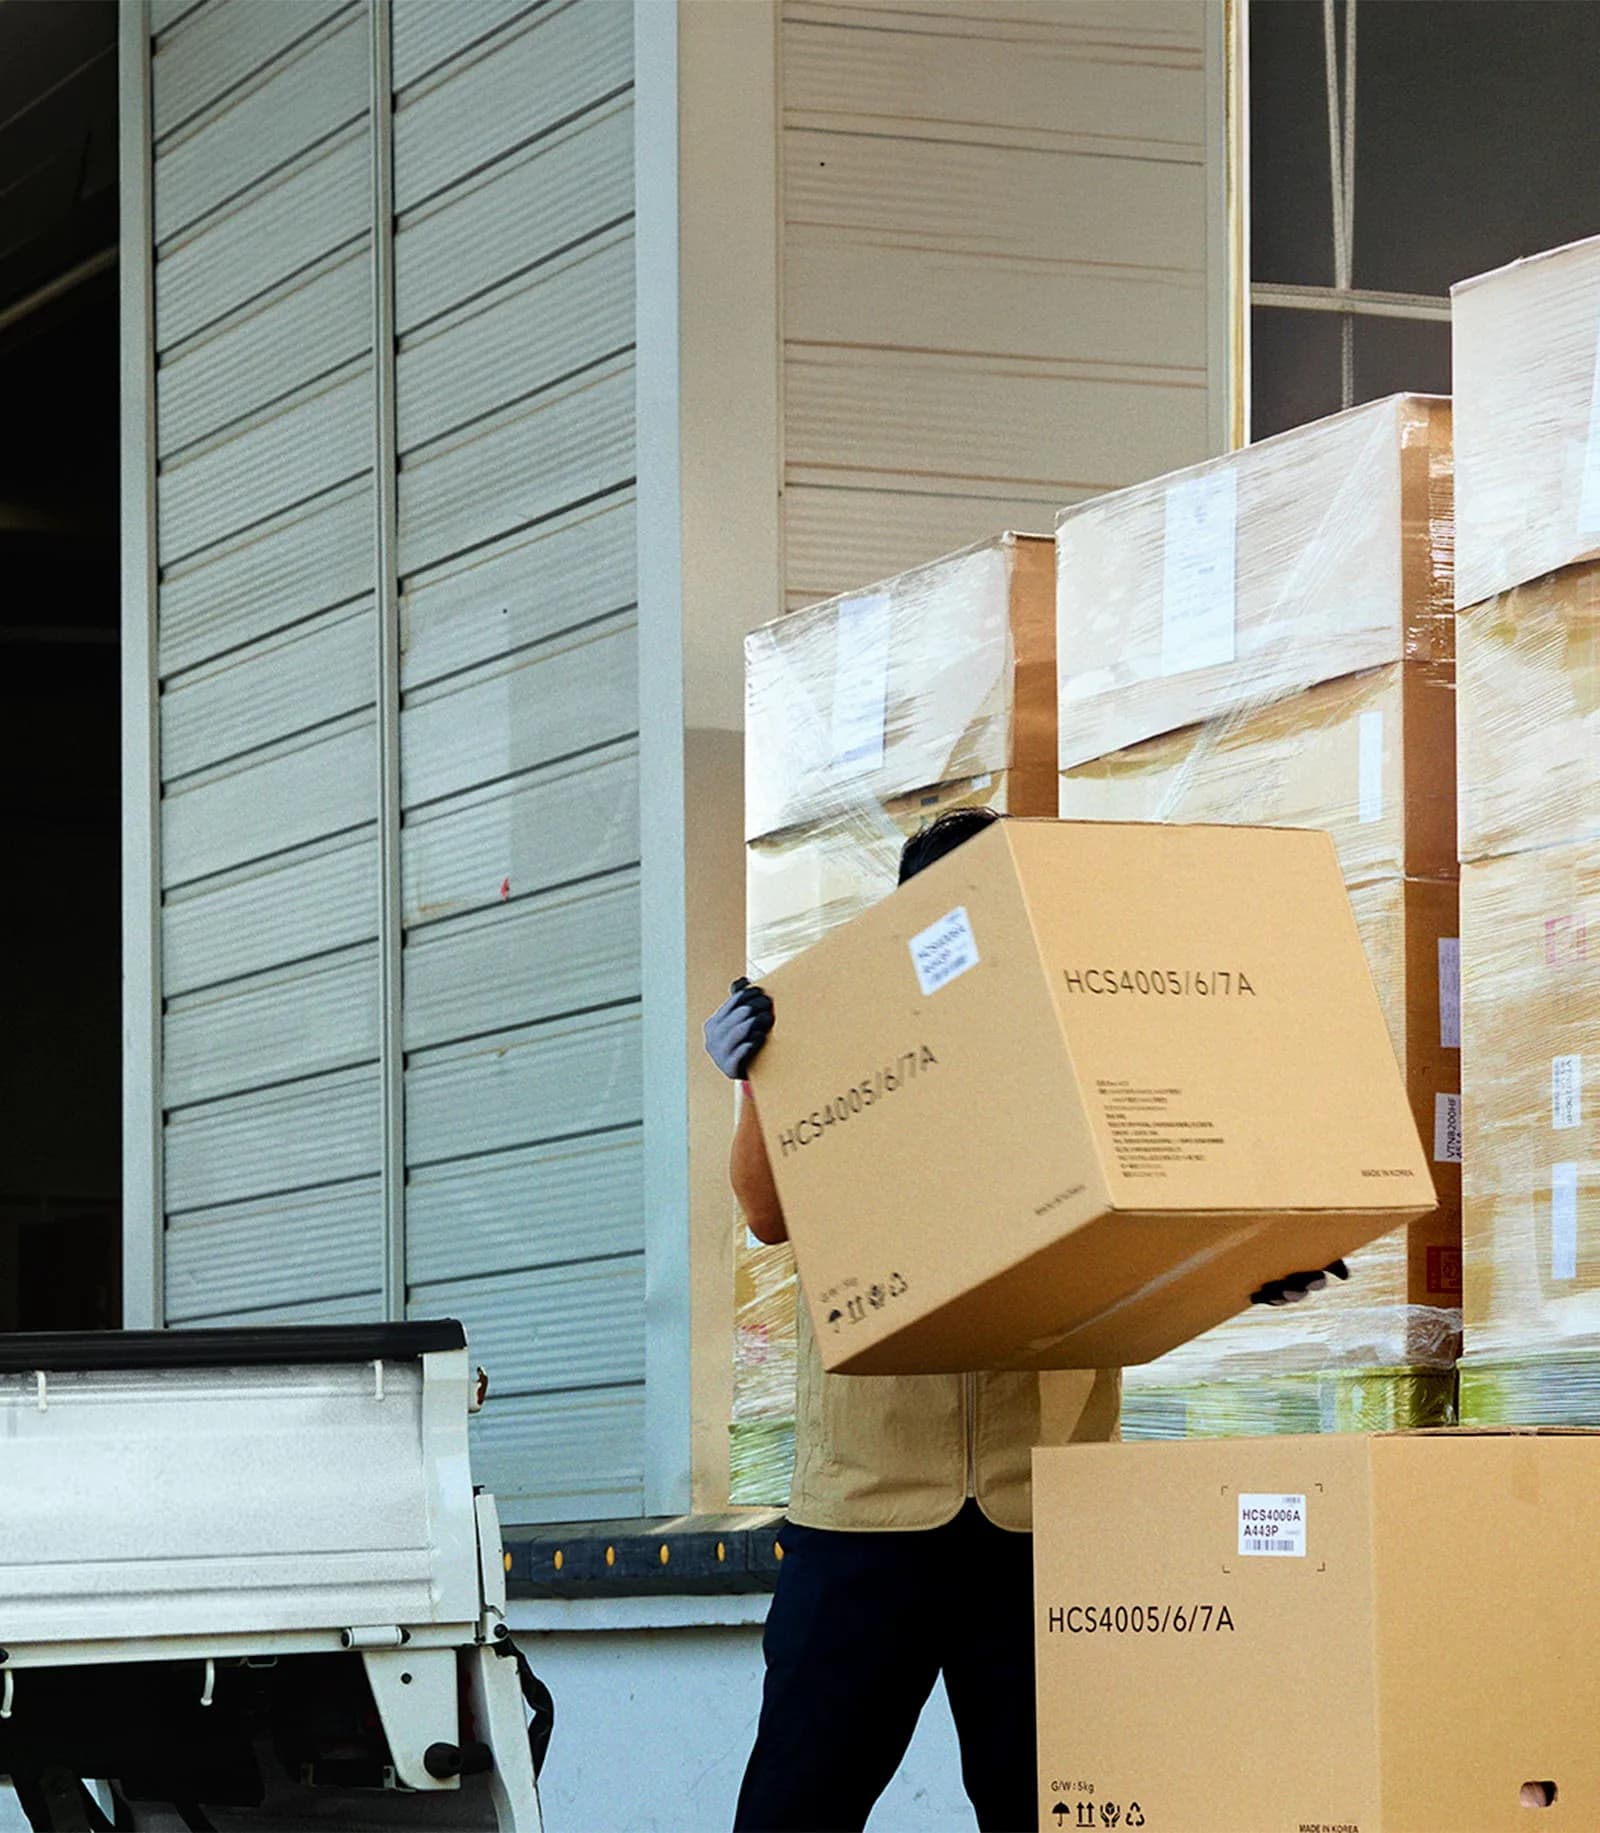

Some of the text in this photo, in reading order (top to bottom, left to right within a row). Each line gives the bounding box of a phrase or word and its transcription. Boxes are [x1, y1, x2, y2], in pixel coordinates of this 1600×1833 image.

[1063, 970, 1256, 997] HCS4005/6/7A
[779, 1045, 939, 1157] HCS4005/6/7A
[1242, 1508, 1302, 1522] HCS4006A
[1243, 1524, 1280, 1537] A443P
[1049, 1605, 1235, 1633] HCS4005/6/7A
[1299, 1824, 1320, 1833] MADE
[1331, 1824, 1360, 1833] KOREA
